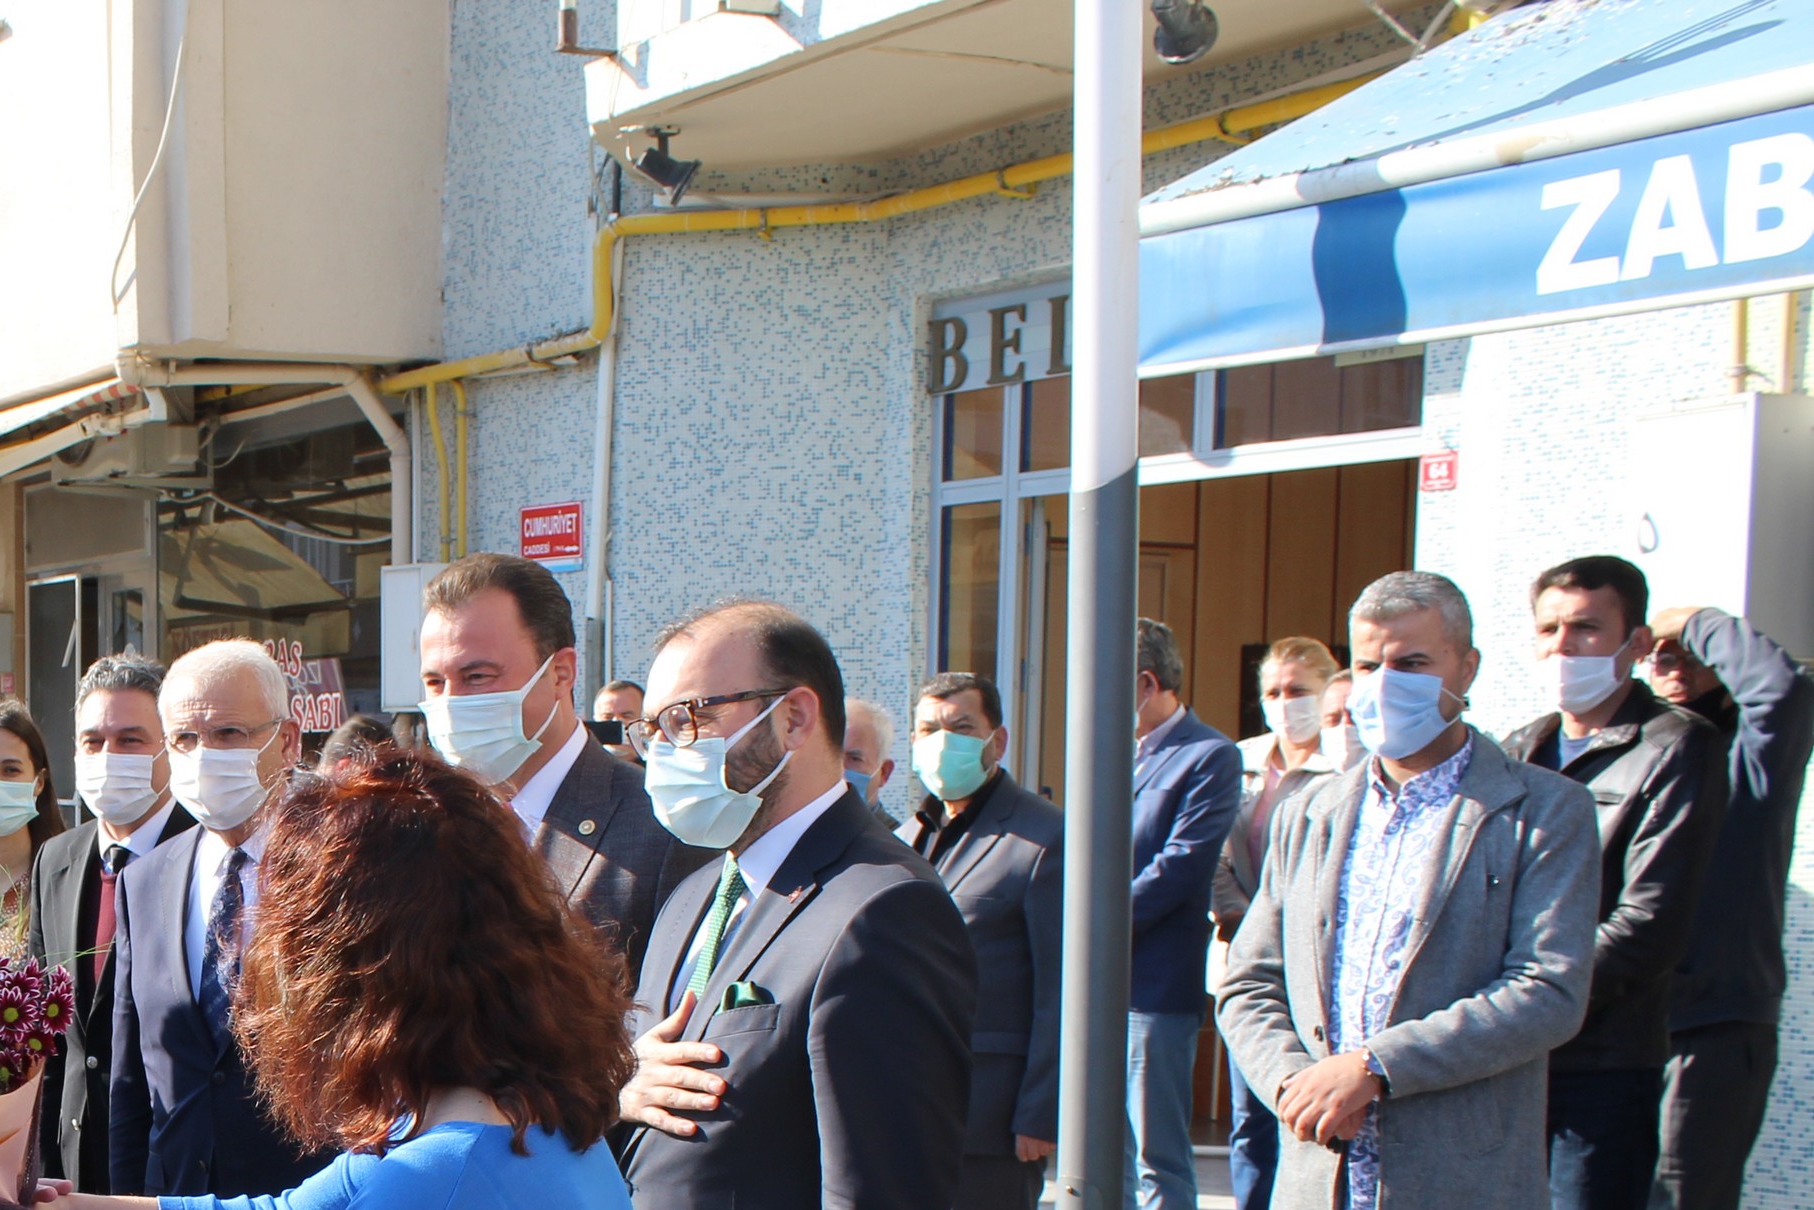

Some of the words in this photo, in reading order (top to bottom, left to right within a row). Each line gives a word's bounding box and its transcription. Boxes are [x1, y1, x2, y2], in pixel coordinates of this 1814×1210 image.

[1536, 132, 1814, 295] ZAB
[1429, 463, 1448, 479] 64
[524, 510, 578, 538] CUMHURİYET
[524, 541, 550, 556] CADDESİ
[265, 637, 302, 677] AS
[291, 693, 341, 732] SABI
